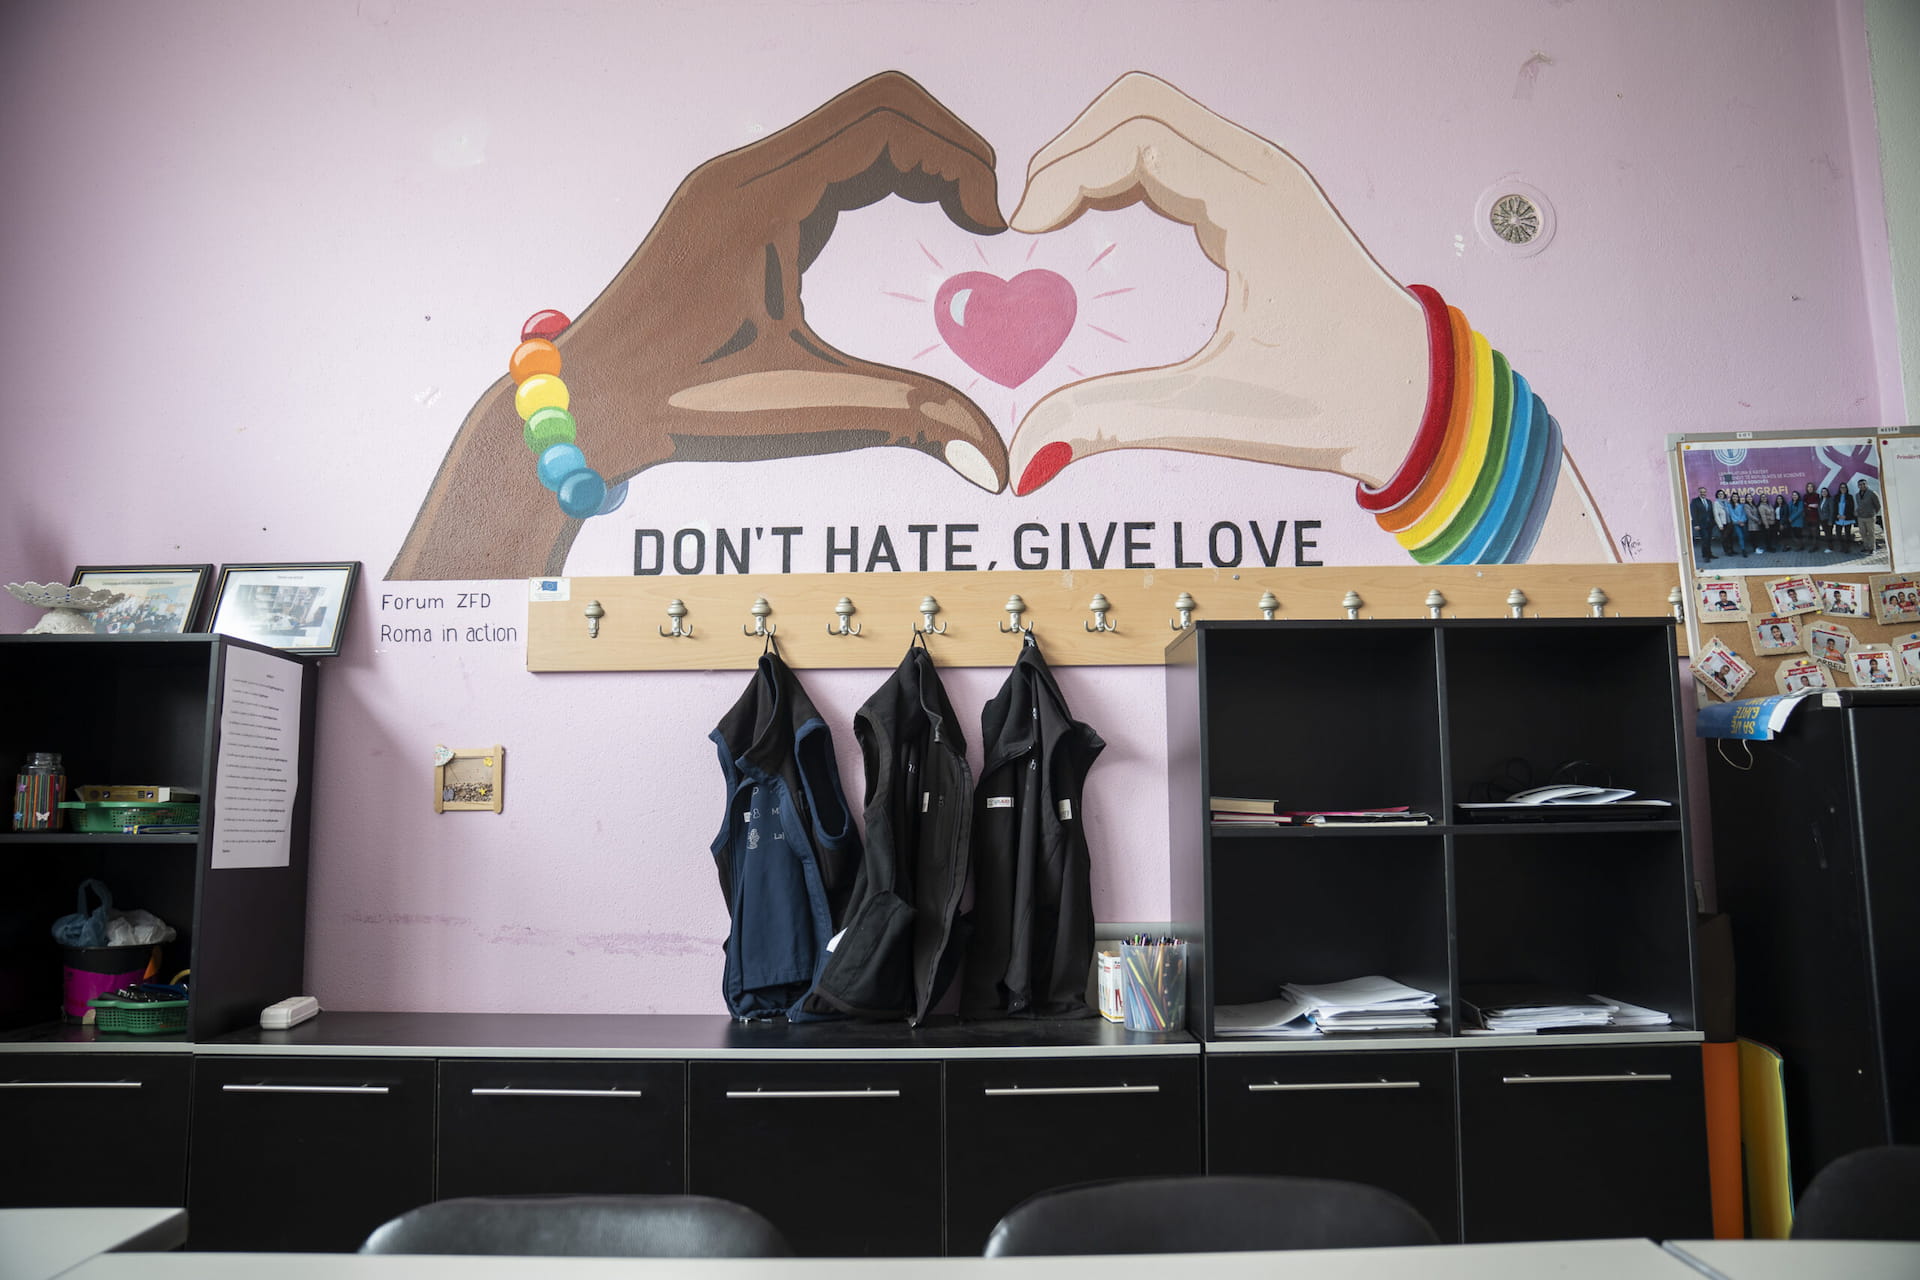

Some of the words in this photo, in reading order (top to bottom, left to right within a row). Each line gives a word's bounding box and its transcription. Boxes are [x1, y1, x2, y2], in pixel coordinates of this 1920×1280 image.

[634, 527, 803, 576] DON'T
[825, 523, 998, 573] HATE,
[1013, 521, 1156, 571] GIVE
[1173, 520, 1324, 569] LOVE
[381, 593, 444, 611] Forum
[456, 592, 492, 609] ZFD
[380, 624, 433, 643] Roma
[442, 624, 458, 642] in
[466, 623, 518, 642] action
